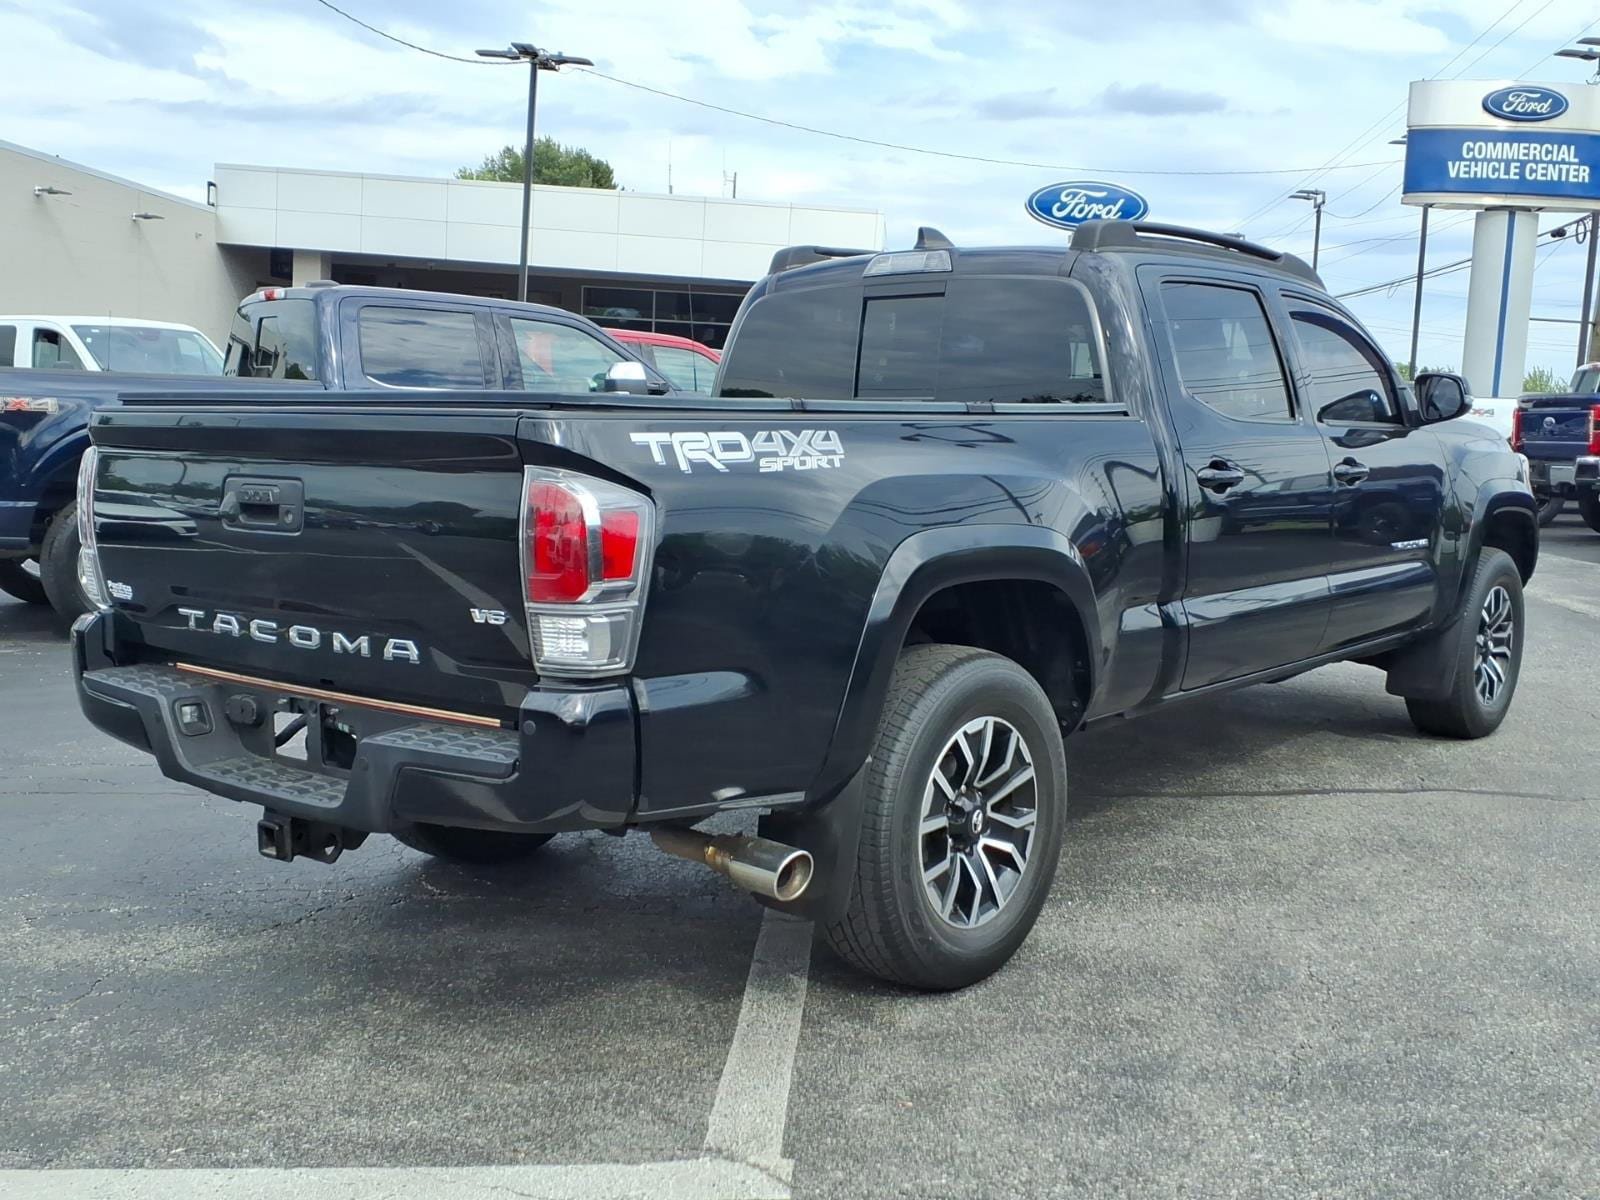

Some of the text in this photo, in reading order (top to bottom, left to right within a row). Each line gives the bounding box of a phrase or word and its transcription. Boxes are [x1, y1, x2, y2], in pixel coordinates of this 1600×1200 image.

[1502, 92, 1553, 114] Ford
[1462, 141, 1579, 163] COMMERCIAL
[1447, 160, 1590, 183] VEHICLE CENTER
[1051, 188, 1126, 219] Ford
[629, 431, 756, 474] TRD
[759, 454, 845, 473] SPORT
[469, 607, 508, 625] V6
[177, 607, 421, 665] TACOMA
